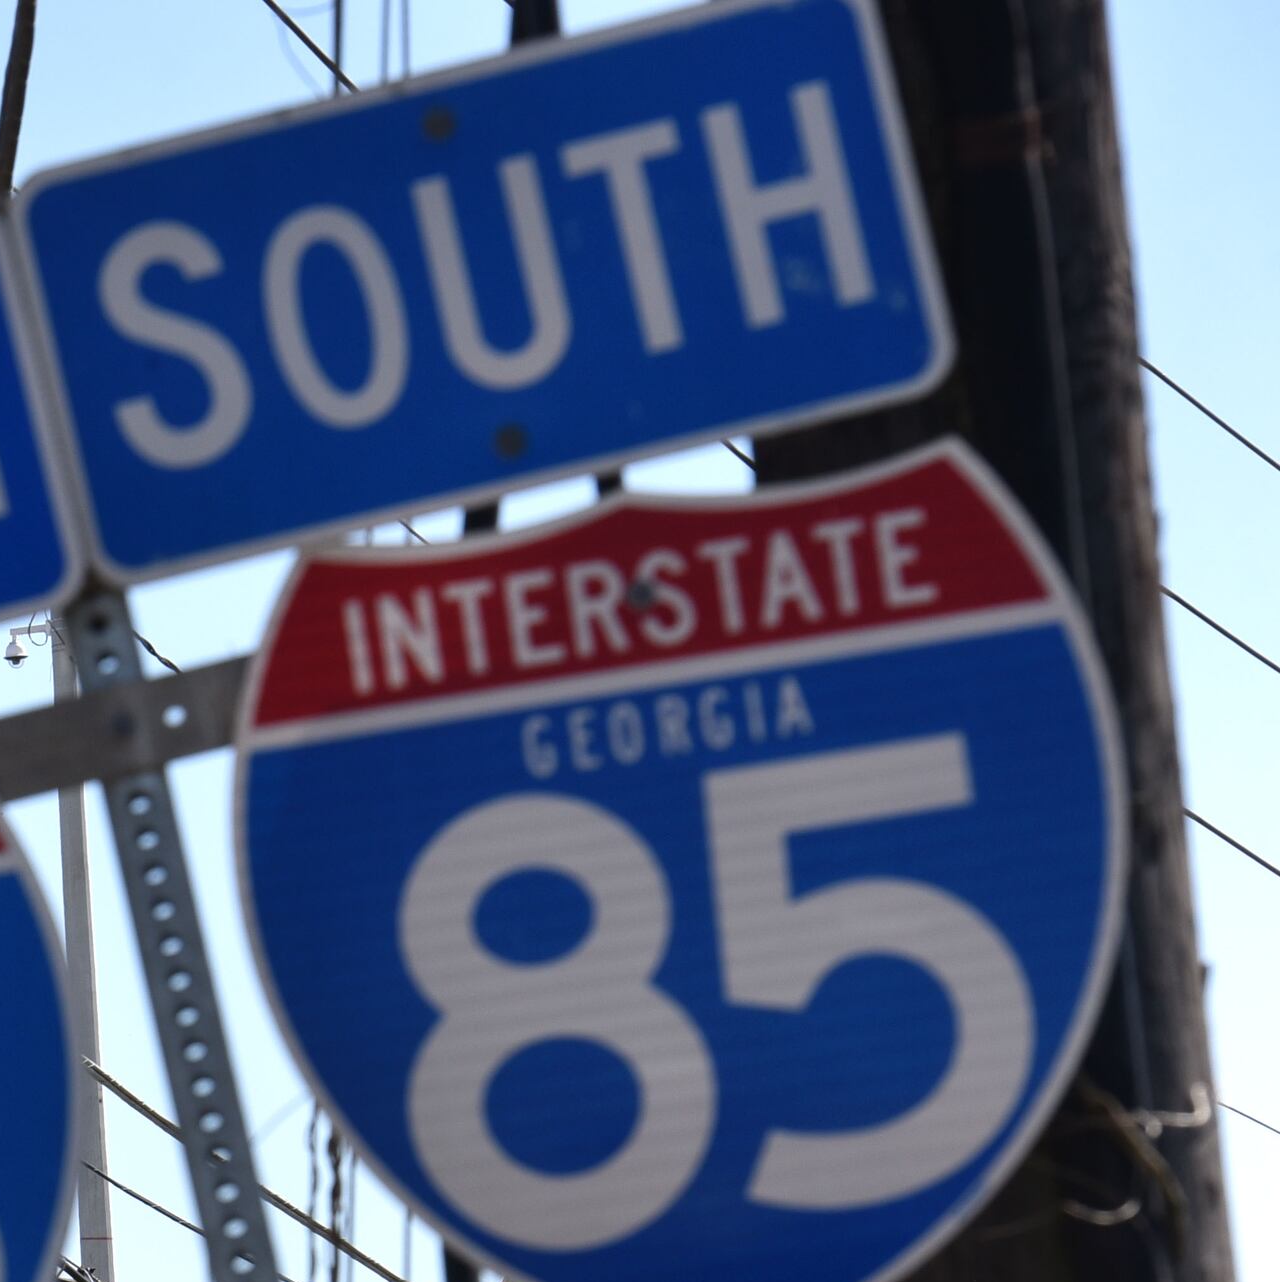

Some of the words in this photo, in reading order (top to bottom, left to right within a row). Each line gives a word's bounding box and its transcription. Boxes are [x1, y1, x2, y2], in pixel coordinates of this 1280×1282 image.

[98, 80, 875, 470] SOUTH
[342, 508, 937, 696] INTERSTATE
[521, 674, 814, 778] GEORGIA
[396, 730, 1035, 1253] 85
